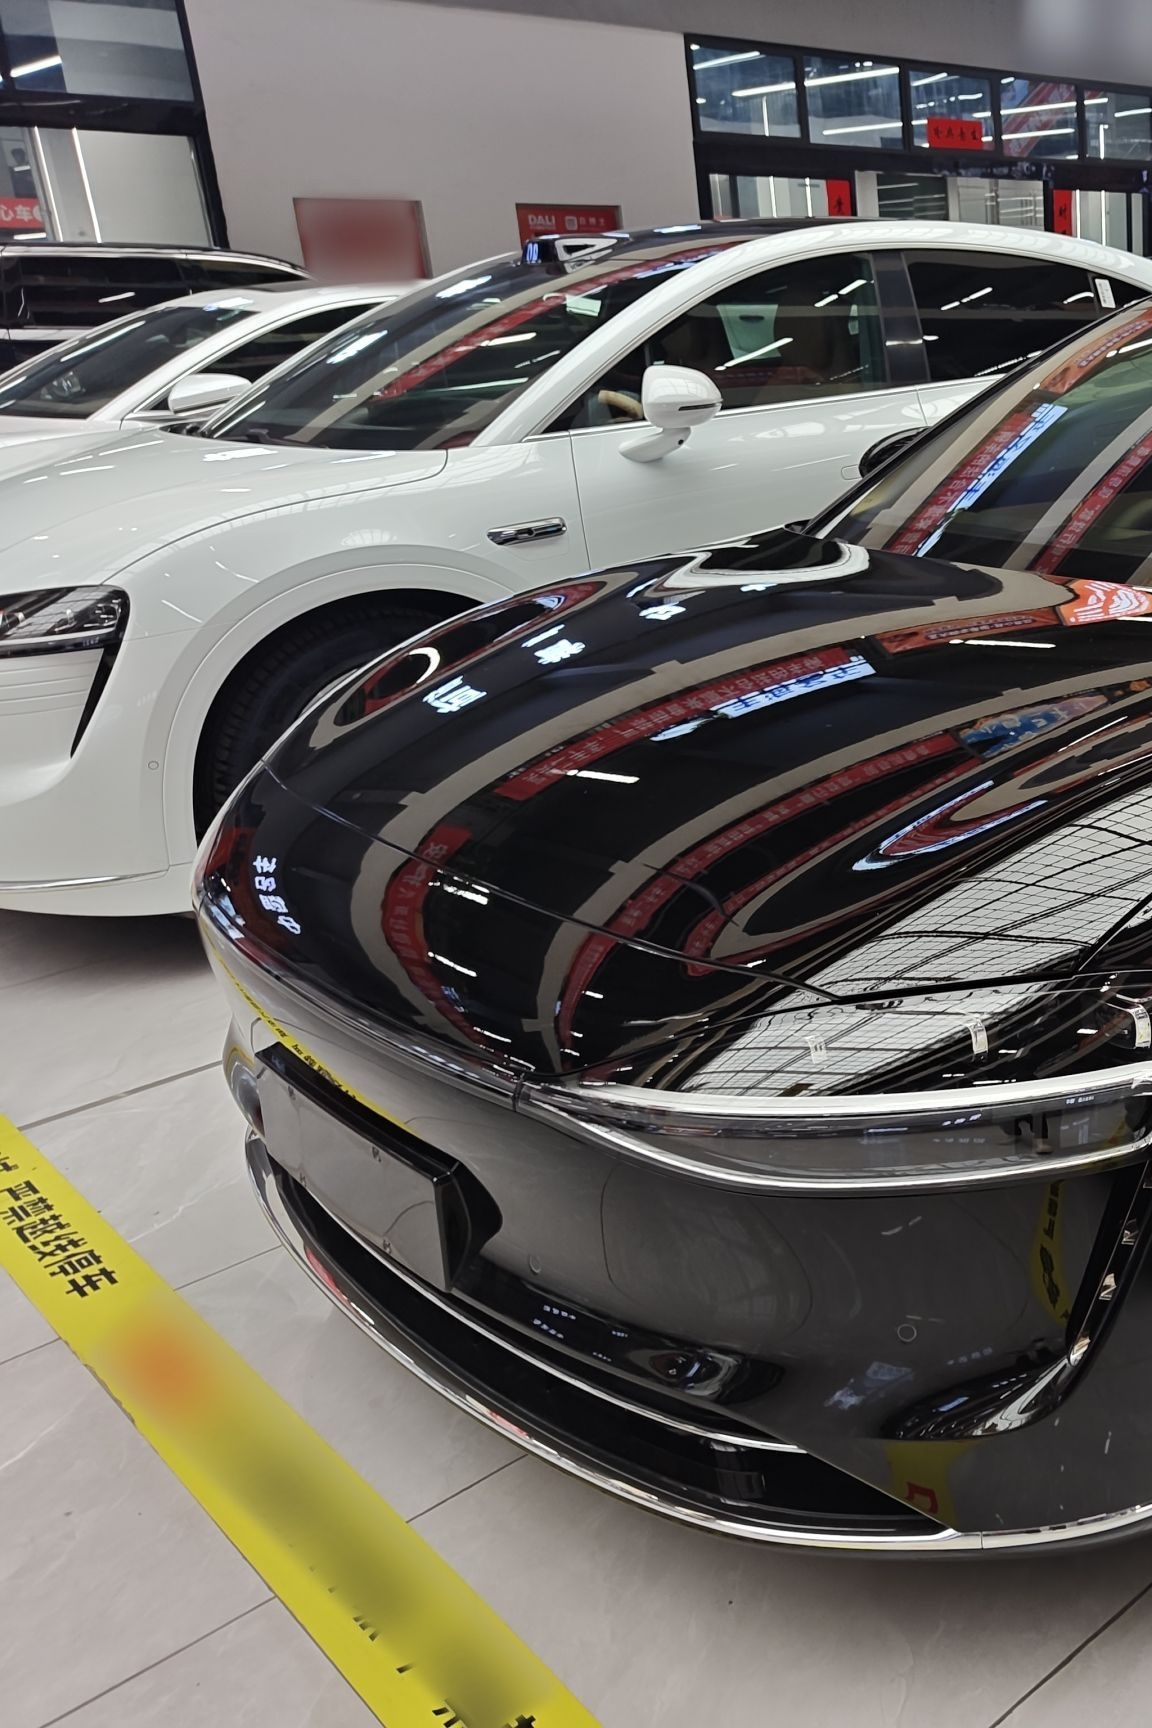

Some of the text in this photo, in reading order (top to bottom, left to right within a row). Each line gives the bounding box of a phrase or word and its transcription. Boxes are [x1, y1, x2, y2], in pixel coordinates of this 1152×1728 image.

[0, 1180, 119, 1298] 严禁越线停车
